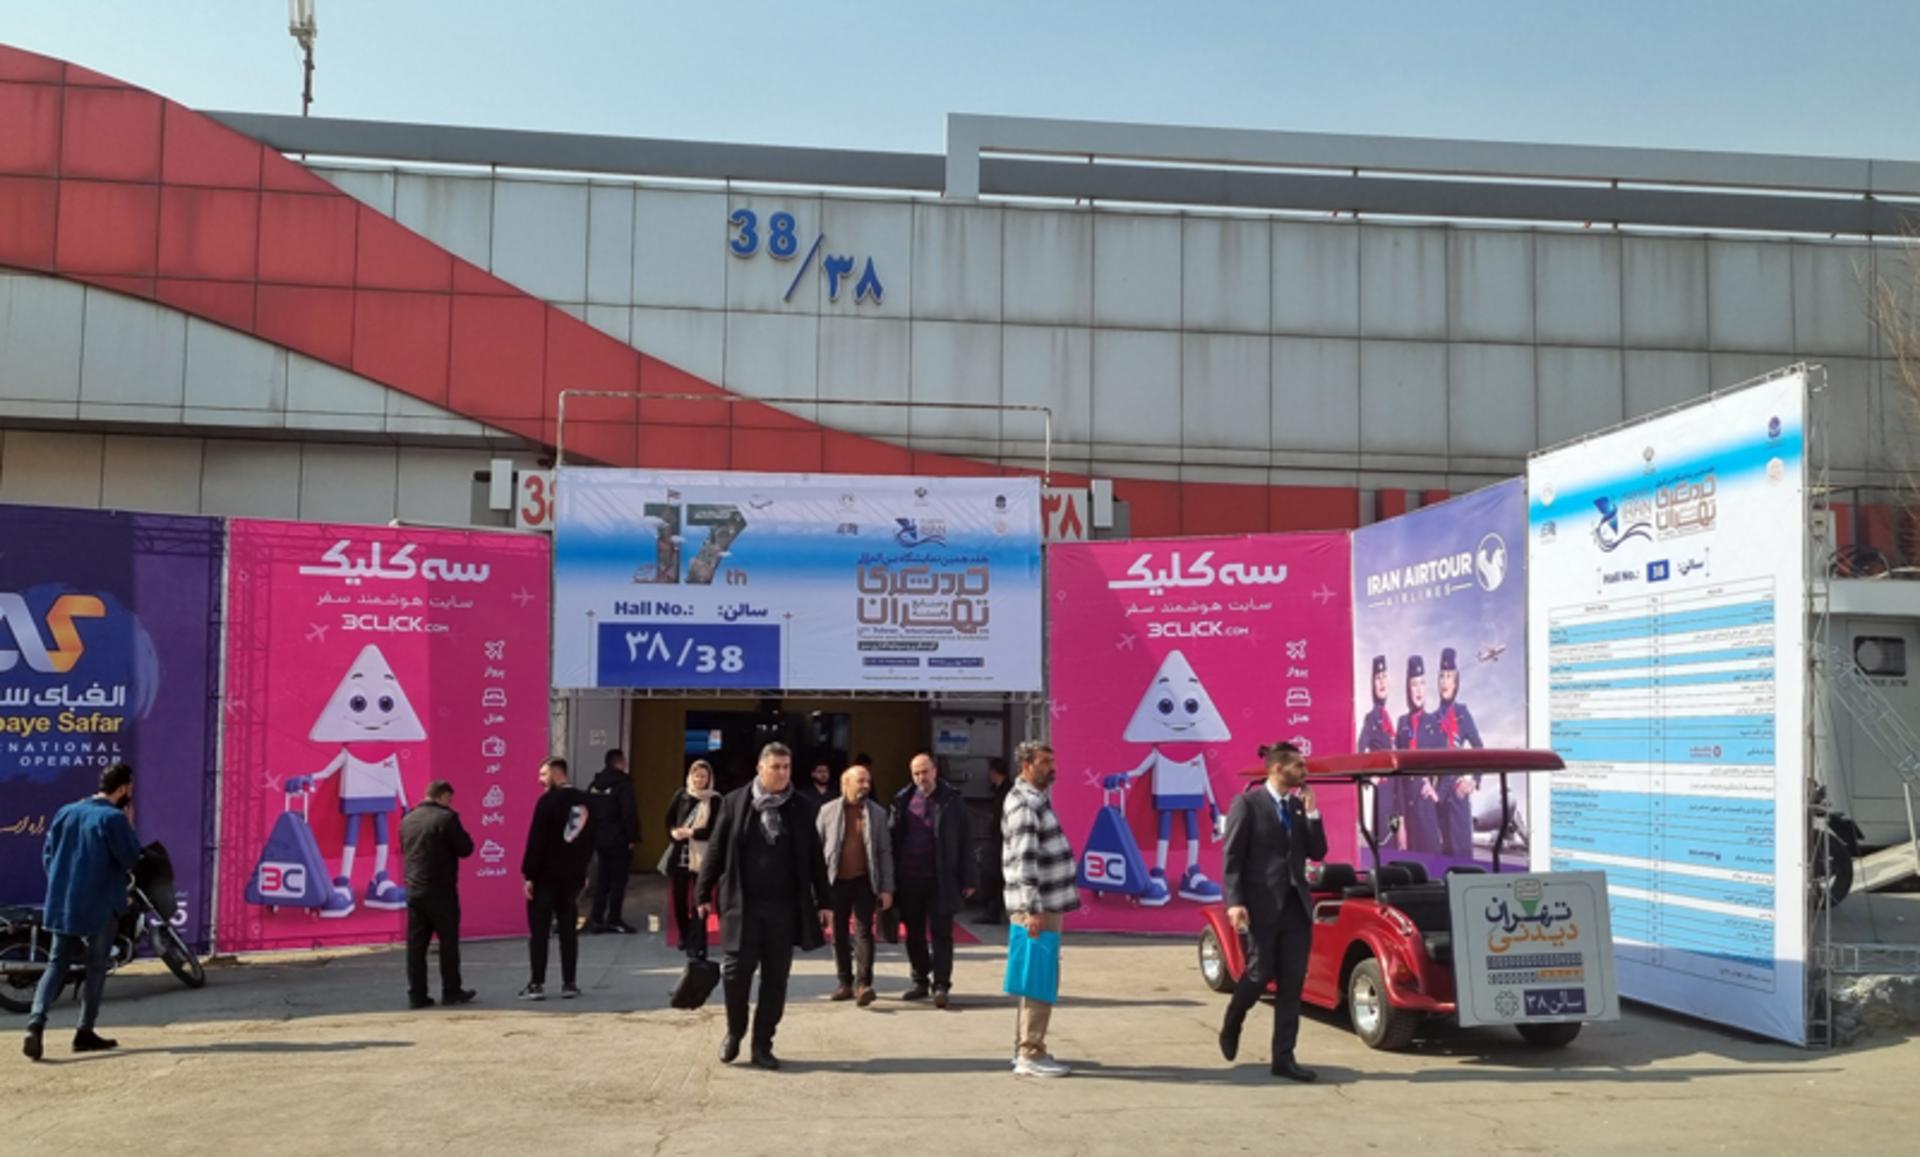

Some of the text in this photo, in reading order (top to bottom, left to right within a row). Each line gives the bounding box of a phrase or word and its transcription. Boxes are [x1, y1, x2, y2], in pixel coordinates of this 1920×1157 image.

[299, 540, 490, 586] سه کلیک
[1108, 551, 1288, 596] سه کلیک
[1367, 552, 1473, 596] IRAN AIRTOUR
[316, 591, 474, 610] سایت هوشمند سفر
[614, 600, 652, 615] Hall
[1124, 597, 1273, 618] سایت هوشمند سفر
[34, 682, 125, 712] الفبای
[57, 711, 124, 732] Safar
[0, 741, 121, 753] NATIONAL
[261, 866, 304, 893] 3C
[1087, 855, 1125, 880] 3C
[1485, 896, 1573, 933] تهران
[1488, 921, 1579, 954] دیدنی
[1546, 990, 1582, 1014] سالن
